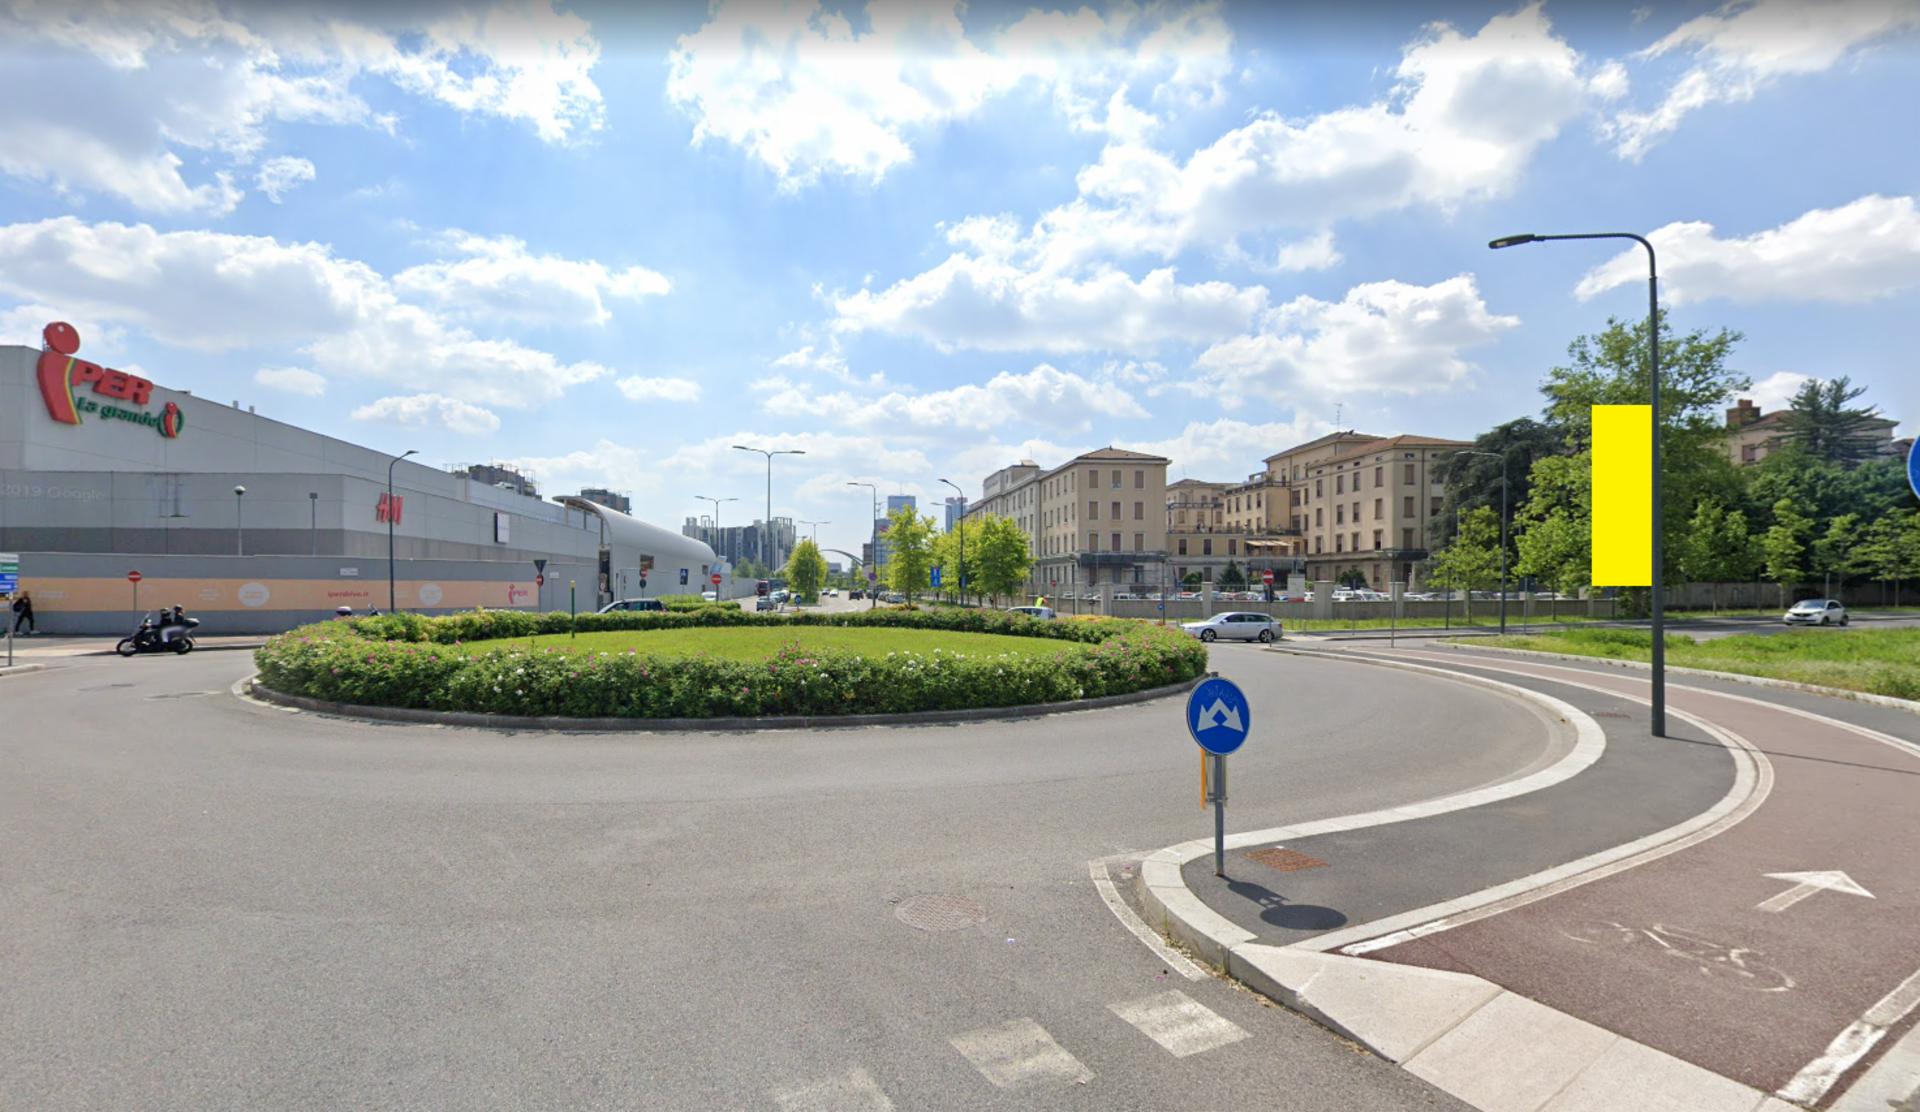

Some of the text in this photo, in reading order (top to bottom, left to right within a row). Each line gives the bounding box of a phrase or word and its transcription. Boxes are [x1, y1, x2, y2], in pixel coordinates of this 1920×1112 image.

[77, 397, 98, 413] La
[100, 405, 159, 428] grande
[375, 493, 404, 525] HM
